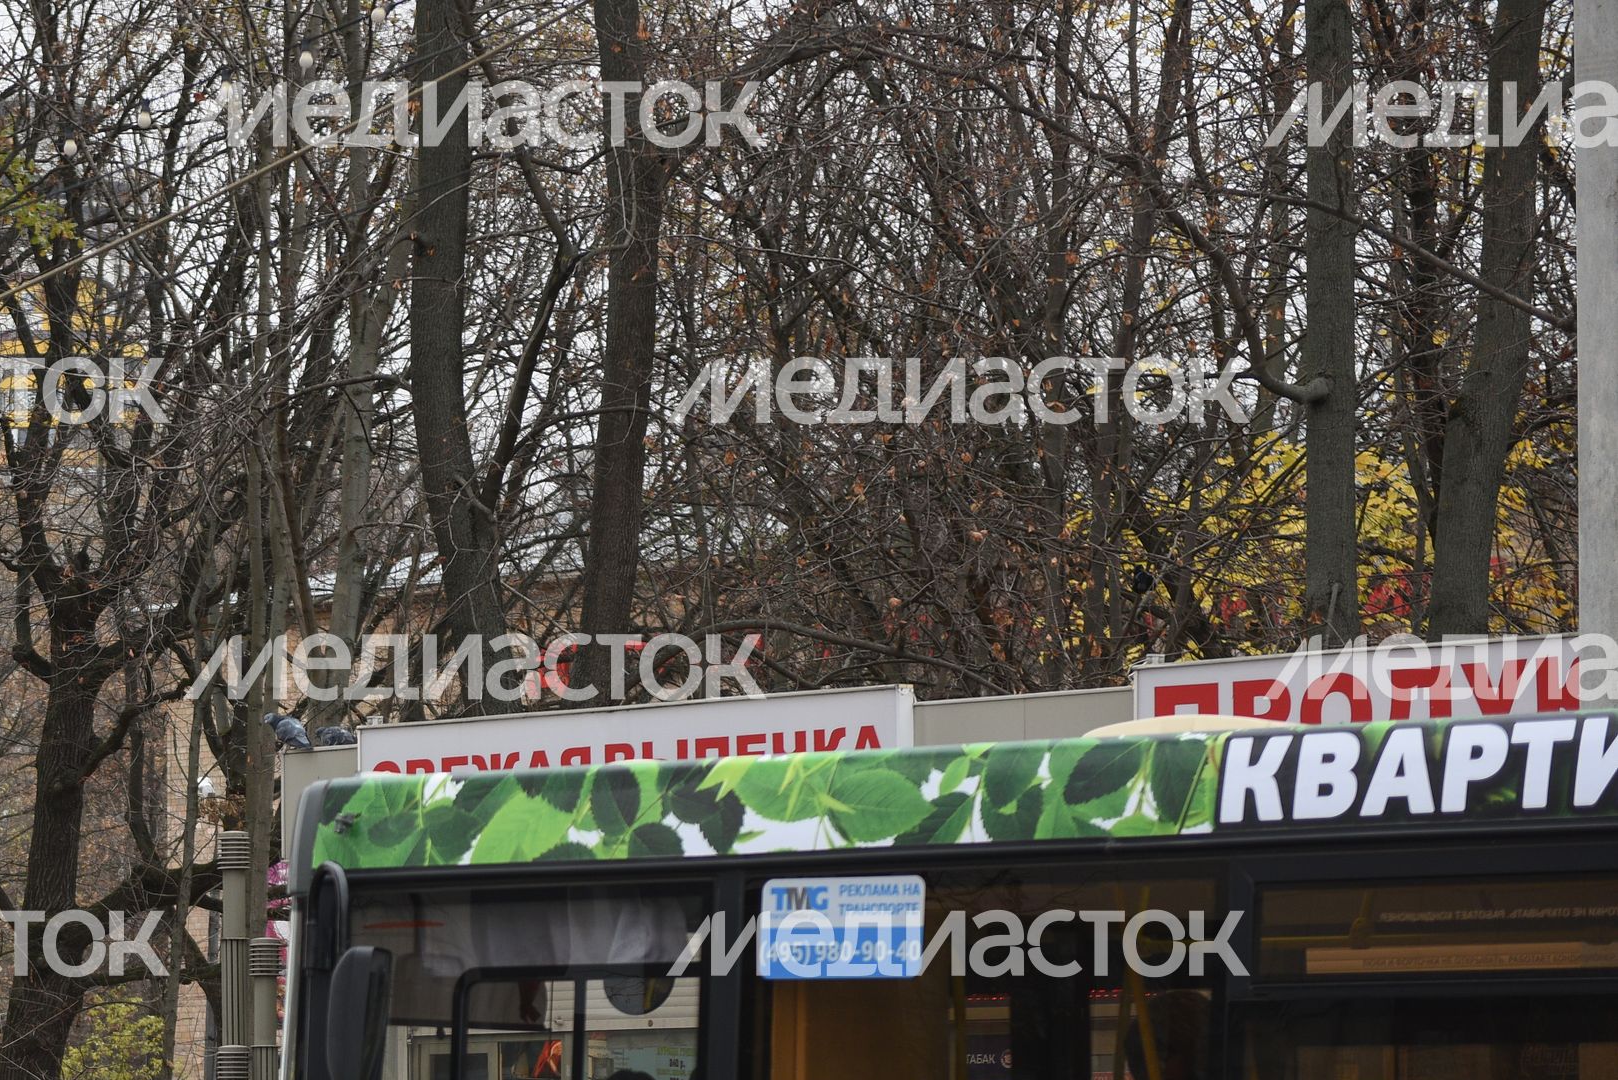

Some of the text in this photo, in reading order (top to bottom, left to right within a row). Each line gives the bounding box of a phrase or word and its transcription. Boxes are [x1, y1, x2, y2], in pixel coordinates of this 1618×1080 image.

[772, 885, 829, 910] TMG
[839, 883, 921, 897] РЕКЛАМА НА
